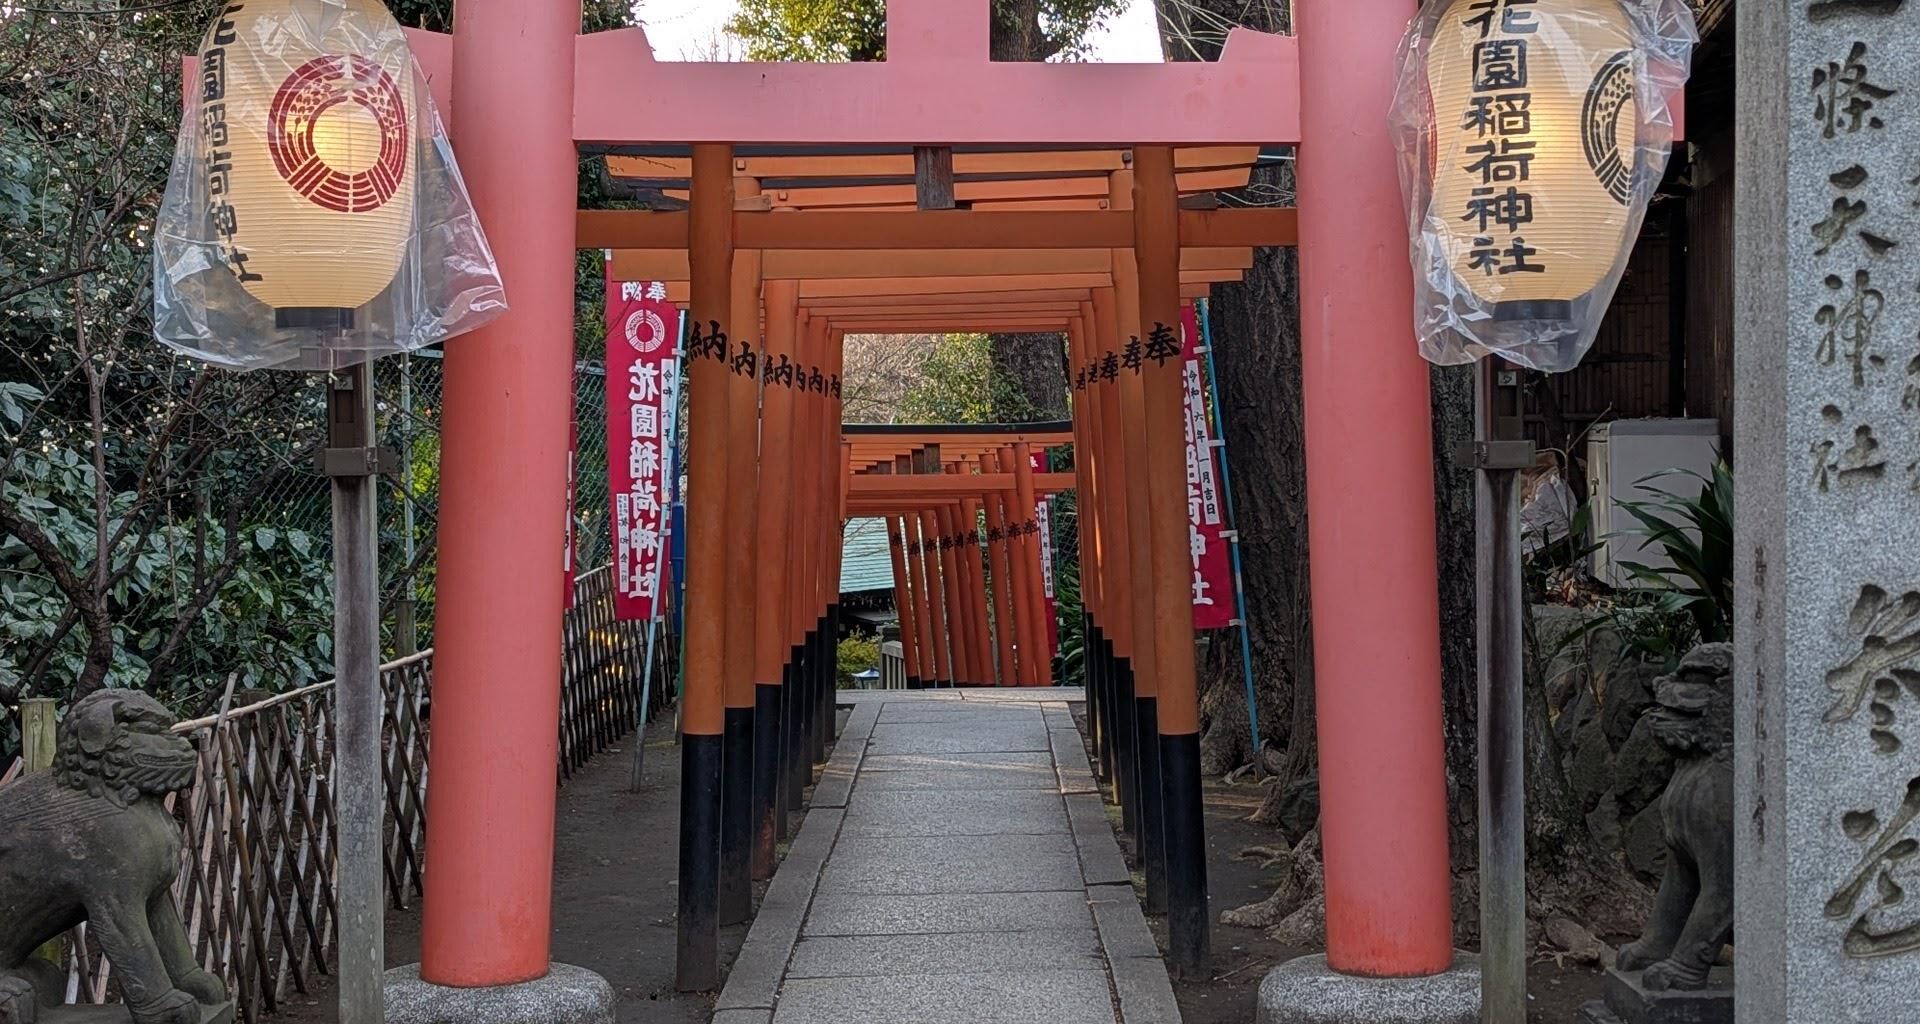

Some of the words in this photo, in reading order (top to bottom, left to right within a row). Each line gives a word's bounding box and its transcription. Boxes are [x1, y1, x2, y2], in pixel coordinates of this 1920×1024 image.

[1461, 0, 1546, 276] 花園稲荷神社
[1808, 0, 1899, 493] 條天神社
[689, 320, 728, 364] 納
[764, 353, 793, 389] 納
[1143, 321, 1181, 369] 奉
[1188, 369, 1217, 516] 令和六年一月吉日
